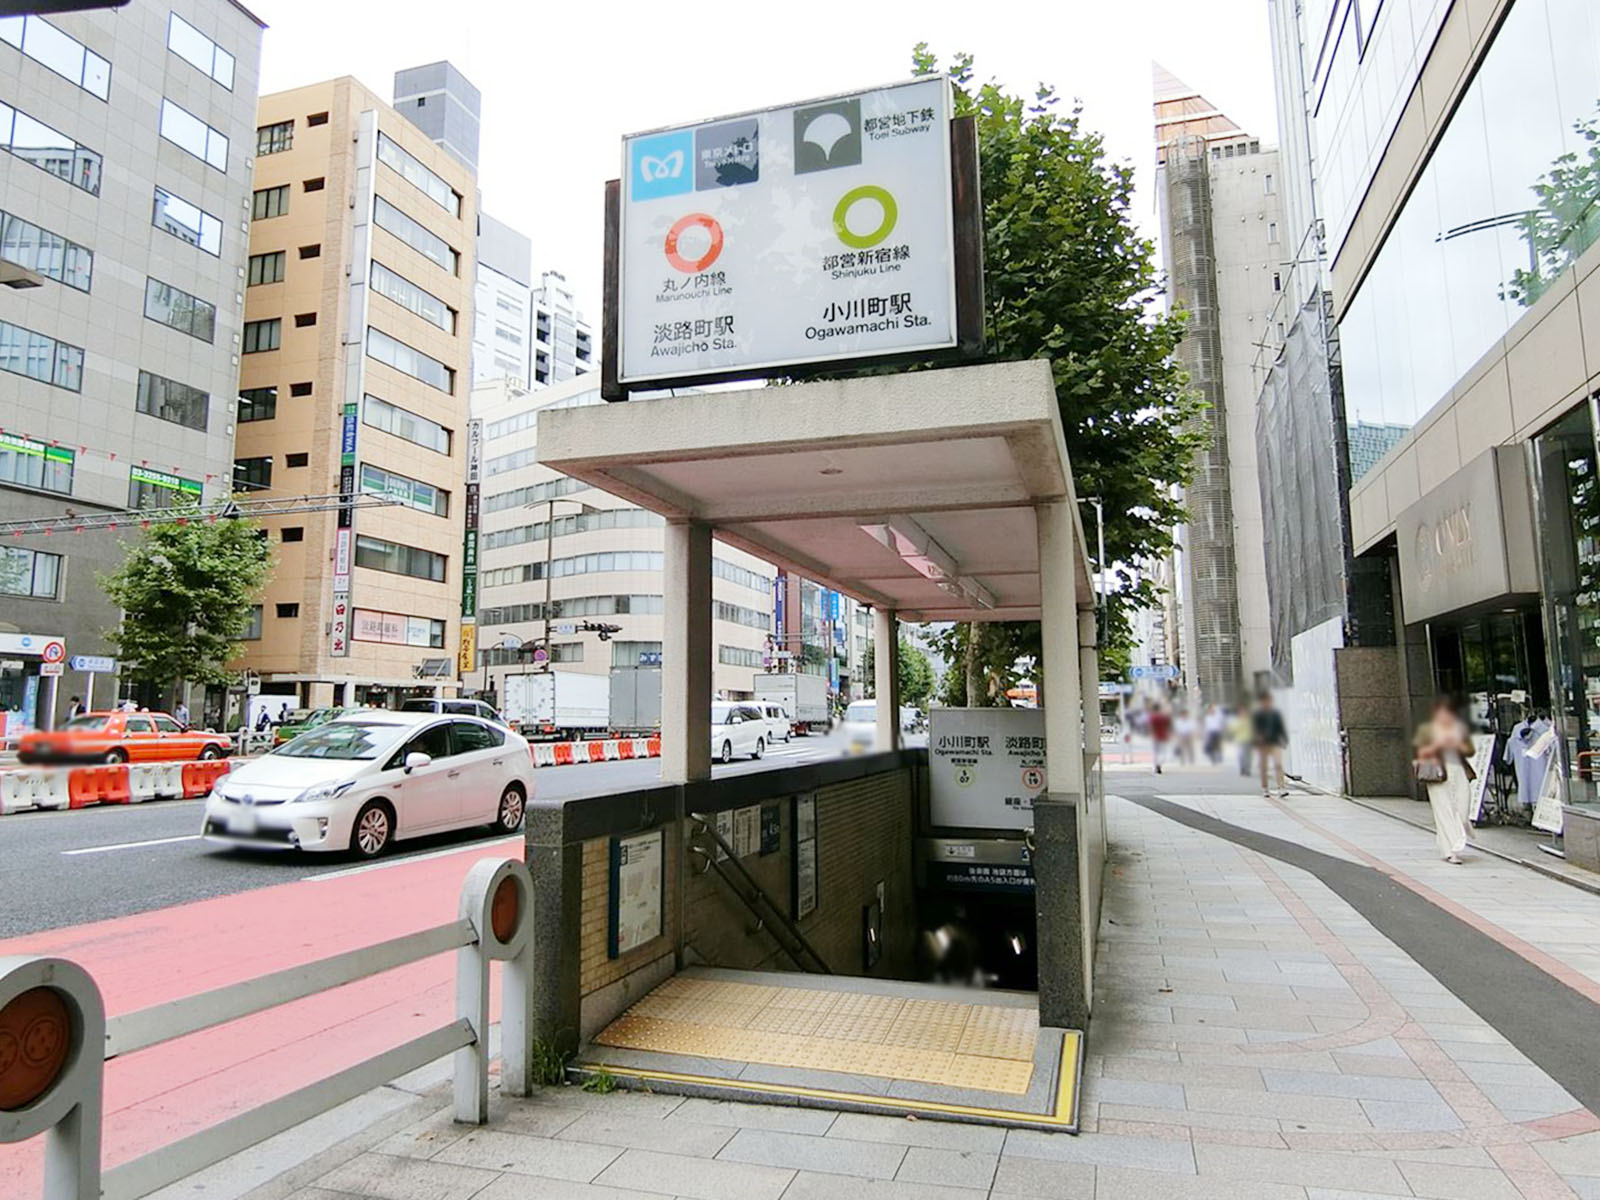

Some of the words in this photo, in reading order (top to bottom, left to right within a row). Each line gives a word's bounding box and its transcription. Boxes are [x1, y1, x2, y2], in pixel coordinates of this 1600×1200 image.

[864, 107, 935, 131] 都営地下鉄
[869, 130, 889, 141] Toei
[892, 122, 931, 137] Subway
[702, 142, 753, 160] 東京メトロ
[822, 245, 911, 271] 都営新宿線
[831, 267, 877, 281] Shinjuku
[879, 262, 902, 275] Line
[662, 271, 727, 293] 丸ノ内線
[655, 286, 711, 303] Marunouchi
[712, 284, 733, 296] Line
[823, 292, 912, 323] 小川町駅
[653, 315, 735, 343] 淡路町駅
[804, 318, 900, 341] Ogawamachi
[903, 314, 932, 329] Sta.
[650, 340, 709, 358] Awajicho
[712, 337, 737, 350] Sta.
[939, 735, 990, 749] 小川町駅
[1005, 736, 1046, 749] 淡路町
[934, 748, 979, 757] Ogawamachi
[1008, 749, 1041, 757] Awajicho
[1028, 777, 1038, 785] 19
